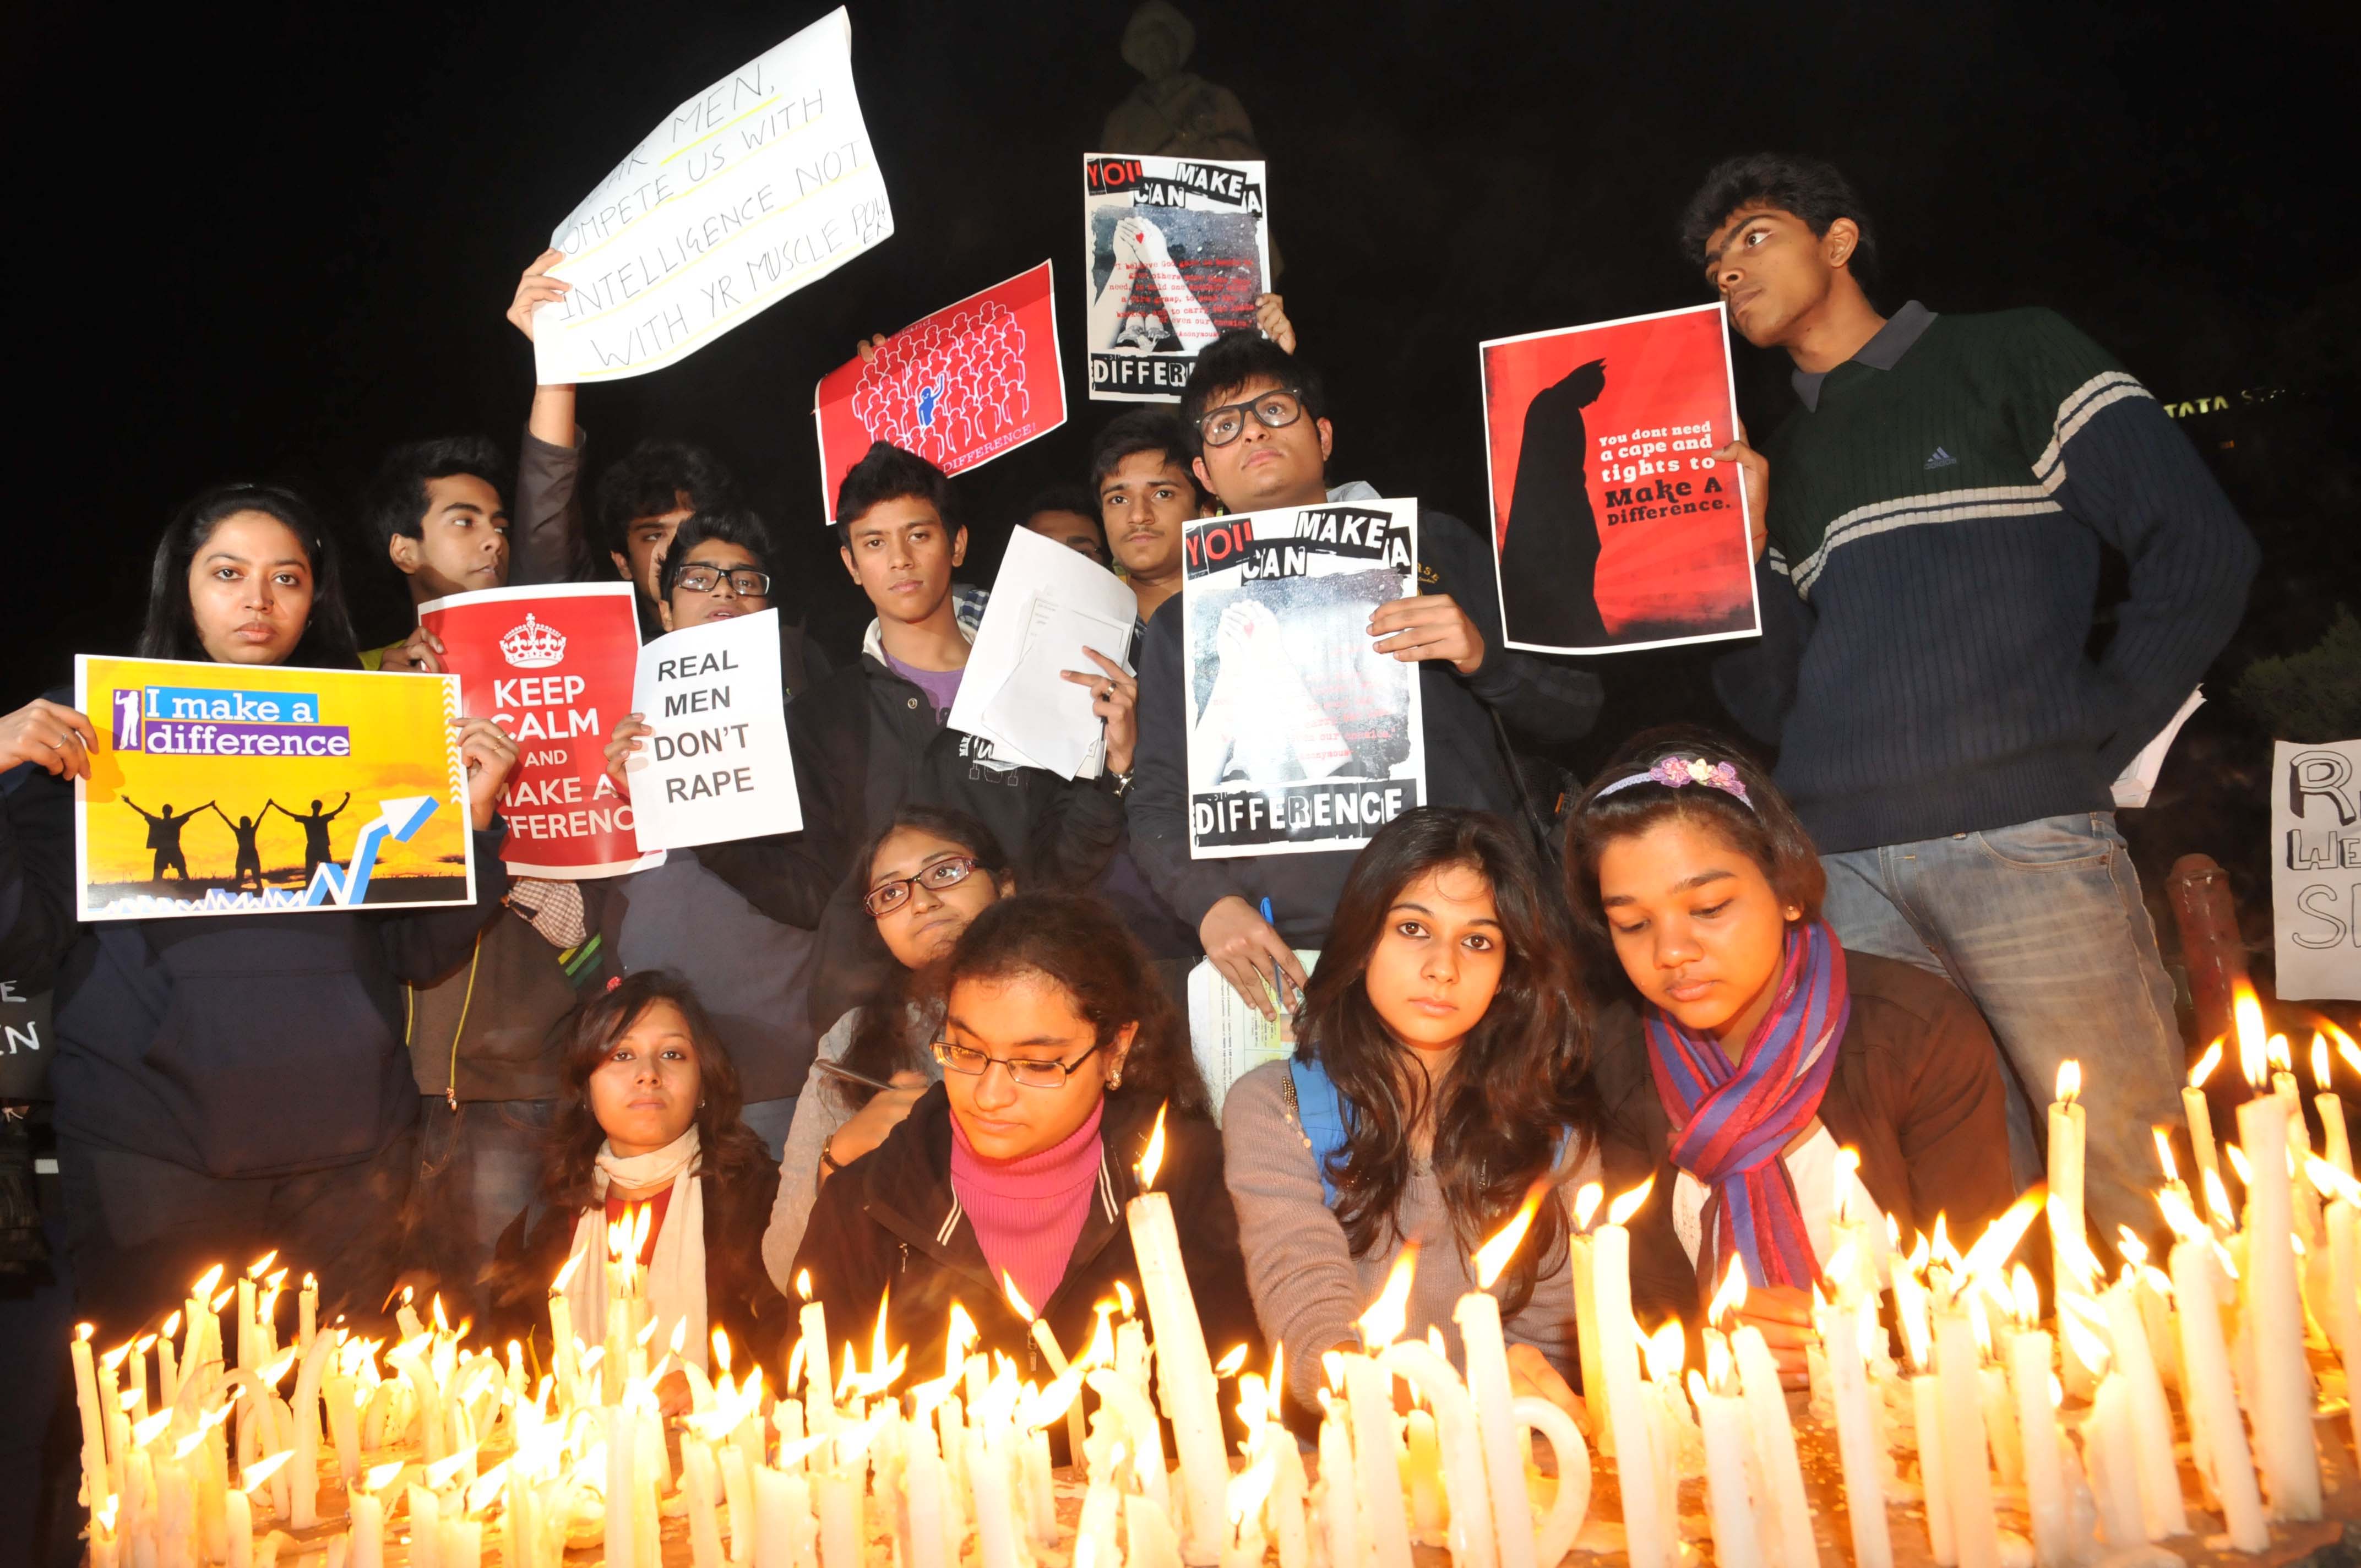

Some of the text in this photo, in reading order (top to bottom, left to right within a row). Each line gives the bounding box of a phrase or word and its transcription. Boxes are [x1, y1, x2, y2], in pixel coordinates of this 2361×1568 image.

[563, 89, 824, 254] OMPETE US WITH
[1134, 183, 1185, 208] CAN
[1176, 162, 1245, 199] MAKE
[1247, 189, 1263, 213] A
[559, 139, 861, 321] INTELLIGENCE NOT
[590, 303, 689, 367] WITH
[700, 274, 741, 318] YR
[747, 219, 842, 292] MUSCLE
[1094, 360, 1188, 387] DIFFER
[2163, 396, 2229, 418] TATA
[943, 422, 1037, 473] DIFFERENCE!
[1599, 421, 1711, 448] You dont need
[1600, 433, 1713, 462] a cape and
[1602, 456, 1716, 483] tights to
[1605, 476, 1723, 508] Make A
[1607, 498, 1731, 526] Difference.
[1242, 548, 1308, 580] CAN
[1295, 512, 1386, 549] MAKE
[1390, 538, 1411, 568] A
[658, 650, 739, 682] REAL
[146, 688, 314, 722] I make a
[494, 675, 585, 709] KEEP
[665, 685, 731, 717] MEN
[147, 725, 350, 755] difference
[654, 723, 749, 761] DON'T
[524, 749, 568, 767] AND
[592, 773, 619, 800] A
[666, 767, 754, 803] RAPE
[1195, 788, 1402, 835] DIFFERENCE
